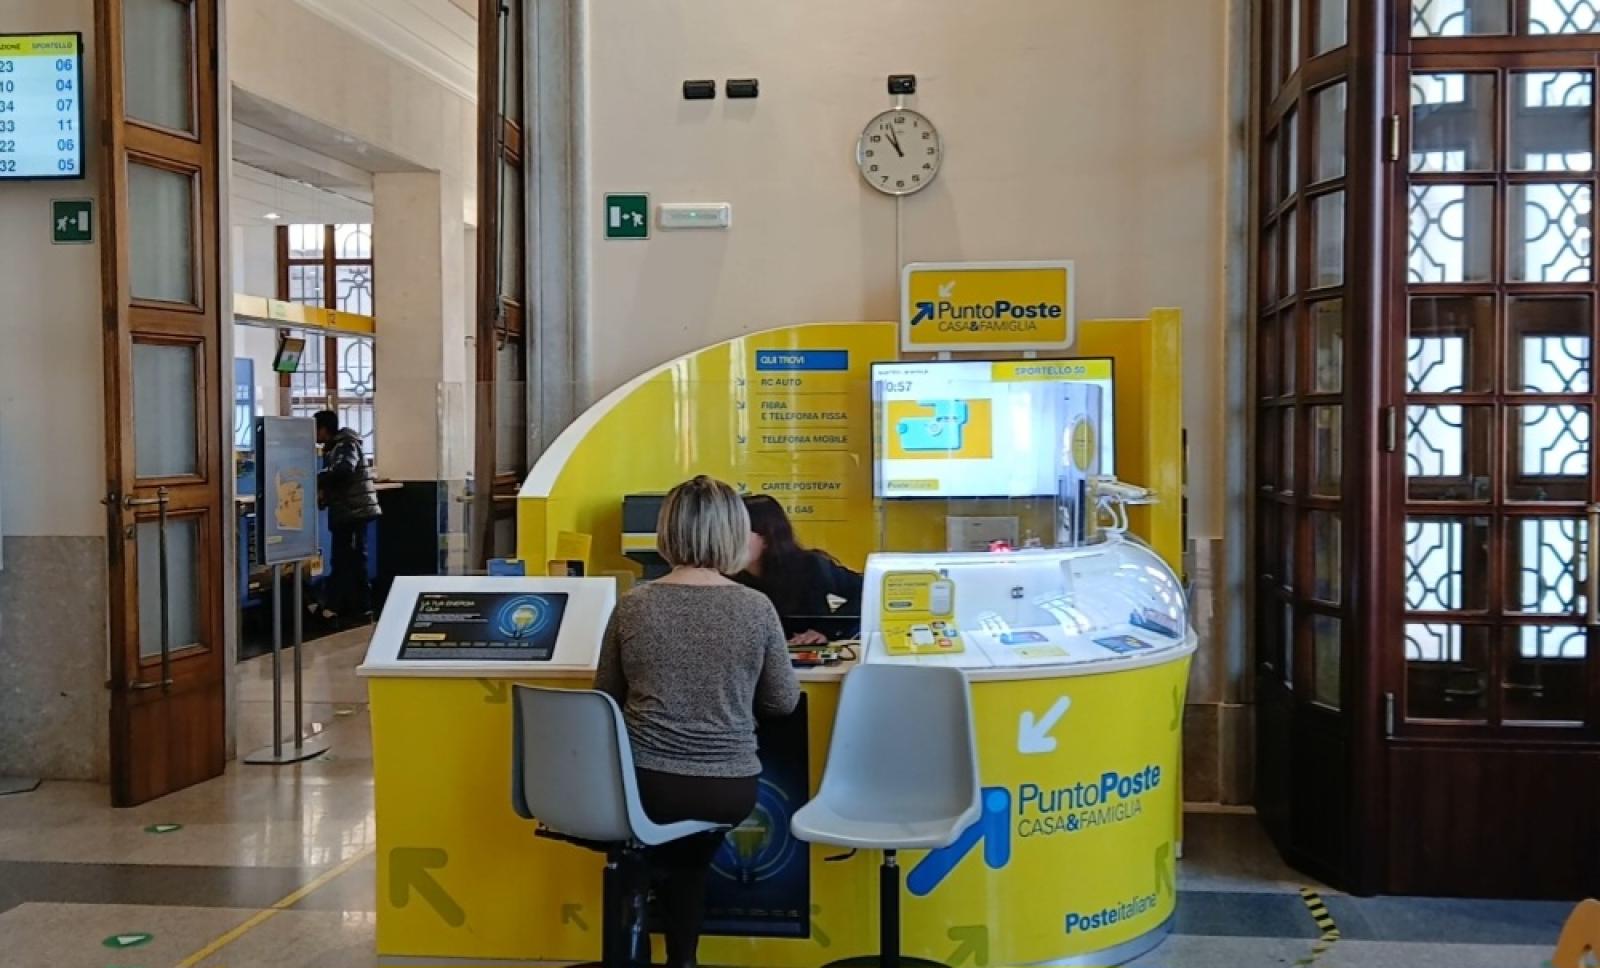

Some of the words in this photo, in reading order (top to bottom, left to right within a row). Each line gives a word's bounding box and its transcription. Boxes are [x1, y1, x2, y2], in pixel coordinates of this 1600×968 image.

[31, 41, 73, 49] SPORTELLO
[55, 59, 72, 71] 06
[56, 80, 72, 91] 04
[57, 99, 73, 111] 07
[57, 120, 72, 131] 11
[57, 139, 74, 151] 06
[58, 159, 74, 171] 05
[937, 300, 1062, 319] PuntoPoste
[937, 320, 1037, 332] CASA&FAMIGLIA
[760, 356, 777, 364] QUI
[778, 356, 805, 364] TROVI
[1015, 367, 1073, 375] SPORTELLO
[761, 378, 774, 386] RC
[775, 378, 802, 386] AUTO
[761, 401, 787, 409] FIBRA
[769, 412, 819, 420] TELEFONIA
[821, 412, 848, 420] FISSA
[762, 435, 811, 443] TELEFONIA
[812, 435, 848, 443] MOBILE
[761, 483, 791, 491] CARTE
[793, 482, 841, 491] POSTEPAY
[794, 505, 814, 513] GAS
[1018, 764, 1161, 816] PuntoPoste
[1017, 799, 1142, 838] CASA&FAMIGLIA
[1065, 893, 1157, 935] Posteitaliane
